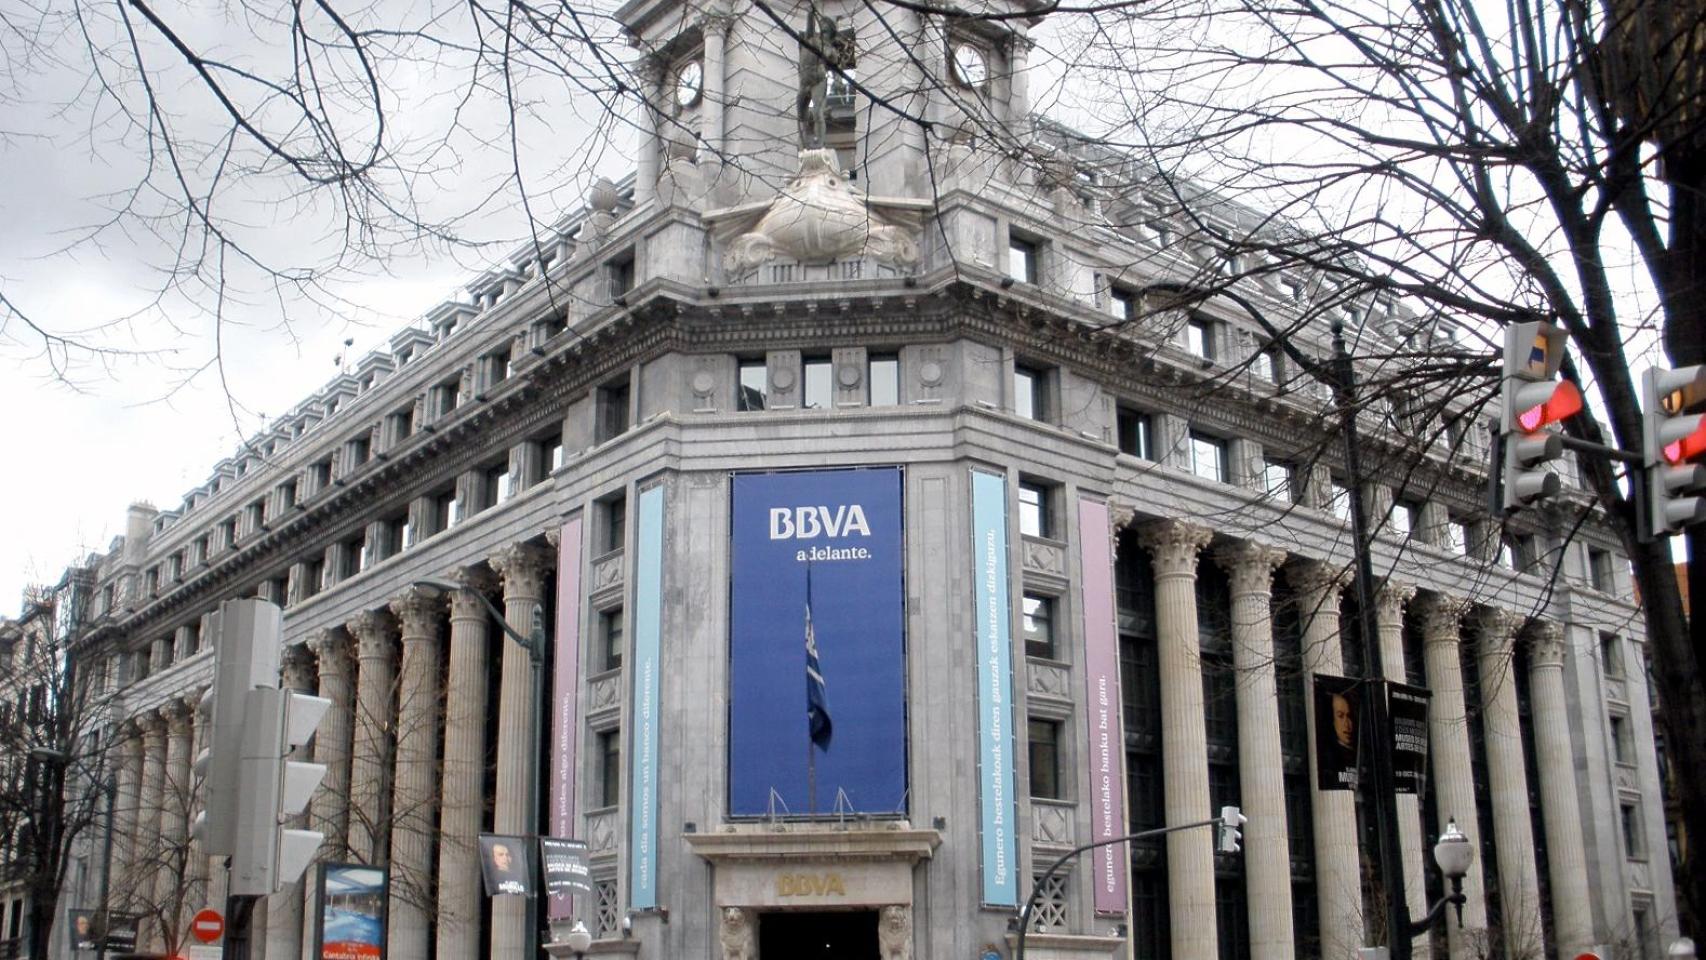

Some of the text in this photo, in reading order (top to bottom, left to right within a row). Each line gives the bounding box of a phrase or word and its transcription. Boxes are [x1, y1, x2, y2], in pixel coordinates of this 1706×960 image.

[769, 504, 871, 541] BBVA
[796, 546, 872, 562] adelante.
[988, 596, 998, 653] eskatzen
[989, 656, 1002, 704] gauzak
[1099, 675, 1108, 706] gara.
[991, 706, 1001, 742] diren
[1099, 709, 1108, 729] bat
[641, 722, 650, 763] banco
[1100, 733, 1110, 772] banku
[560, 754, 568, 780] algo
[642, 766, 649, 783] un
[992, 744, 1003, 825] bestelakoak
[641, 787, 649, 830] somos
[1100, 775, 1112, 837] bestelako
[640, 857, 648, 889] cada
[994, 828, 1006, 886] Egunero
[778, 871, 846, 896] BBVA
